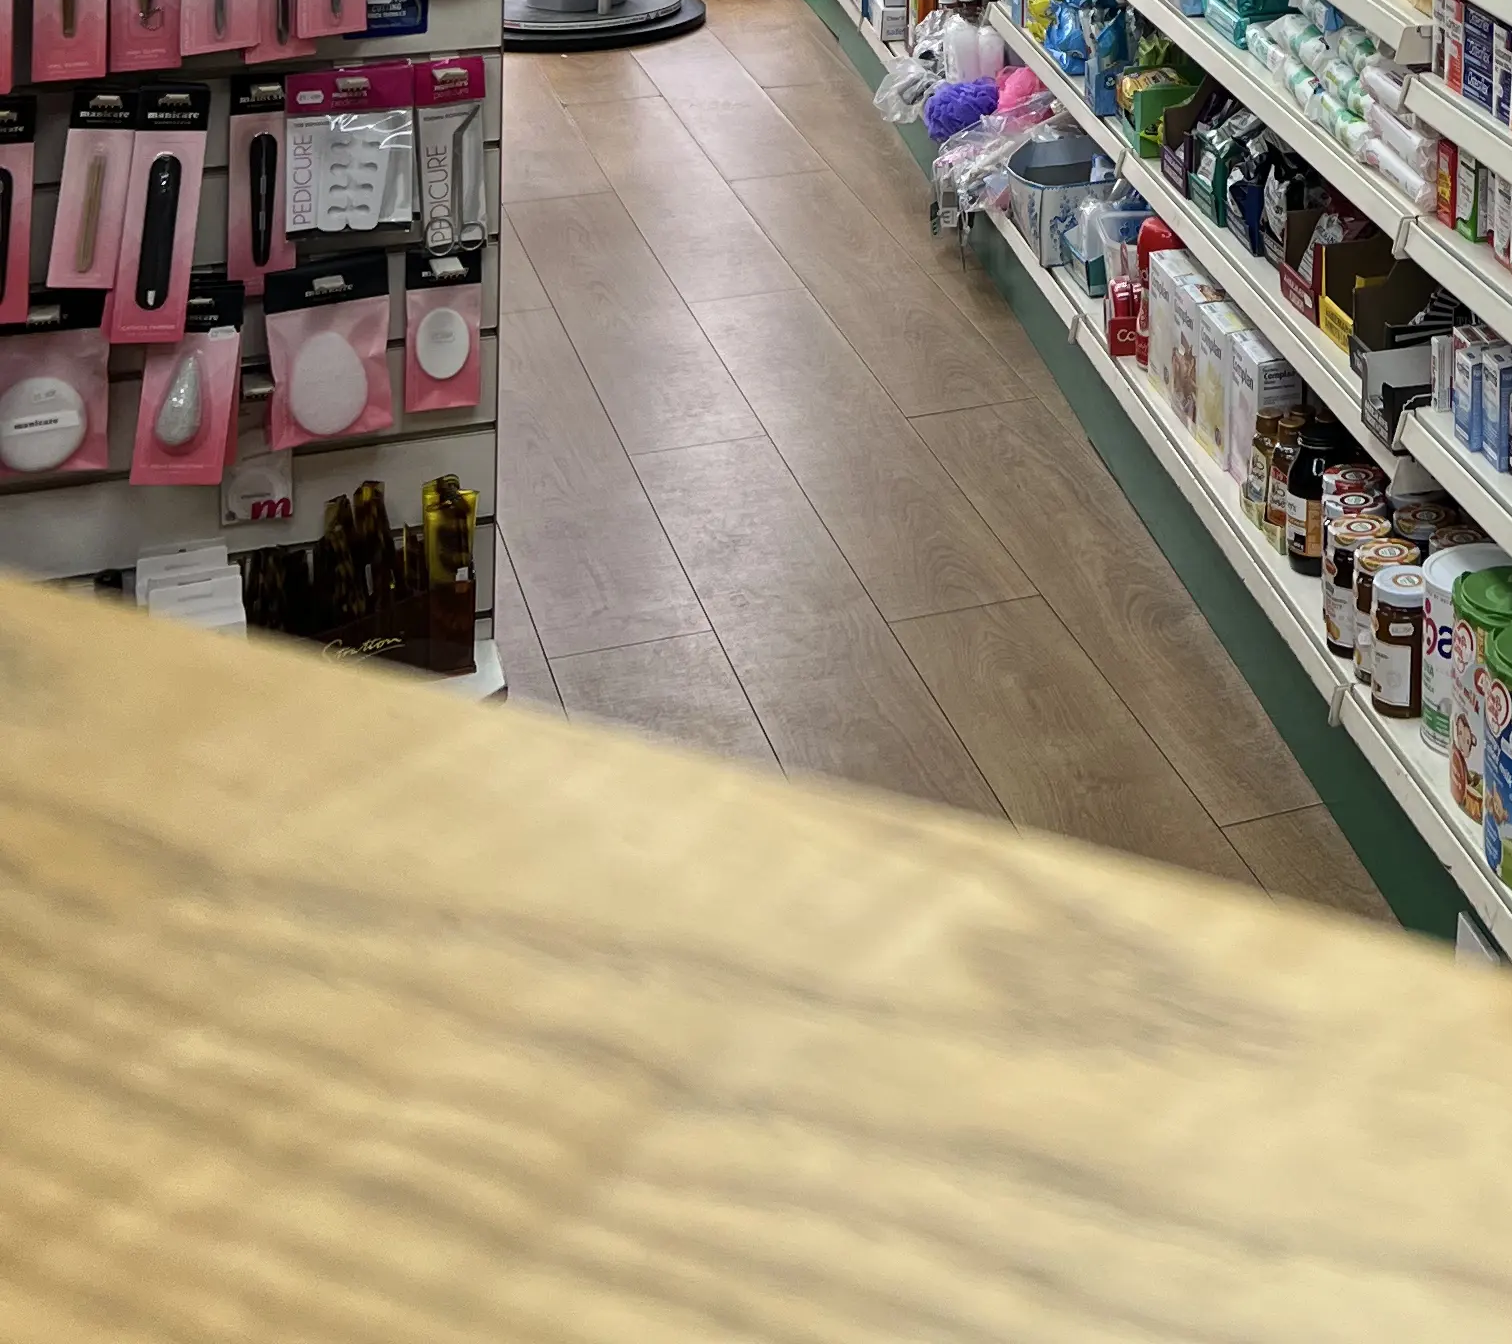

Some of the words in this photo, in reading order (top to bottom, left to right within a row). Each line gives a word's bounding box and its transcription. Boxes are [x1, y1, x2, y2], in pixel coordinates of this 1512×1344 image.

[79, 110, 130, 120] manicare
[147, 111, 200, 120] manicare
[293, 134, 314, 226] PEDICURE
[426, 145, 452, 244] PEDICURE
[1201, 326, 1222, 361] Complan
[1232, 354, 1254, 392] Complan
